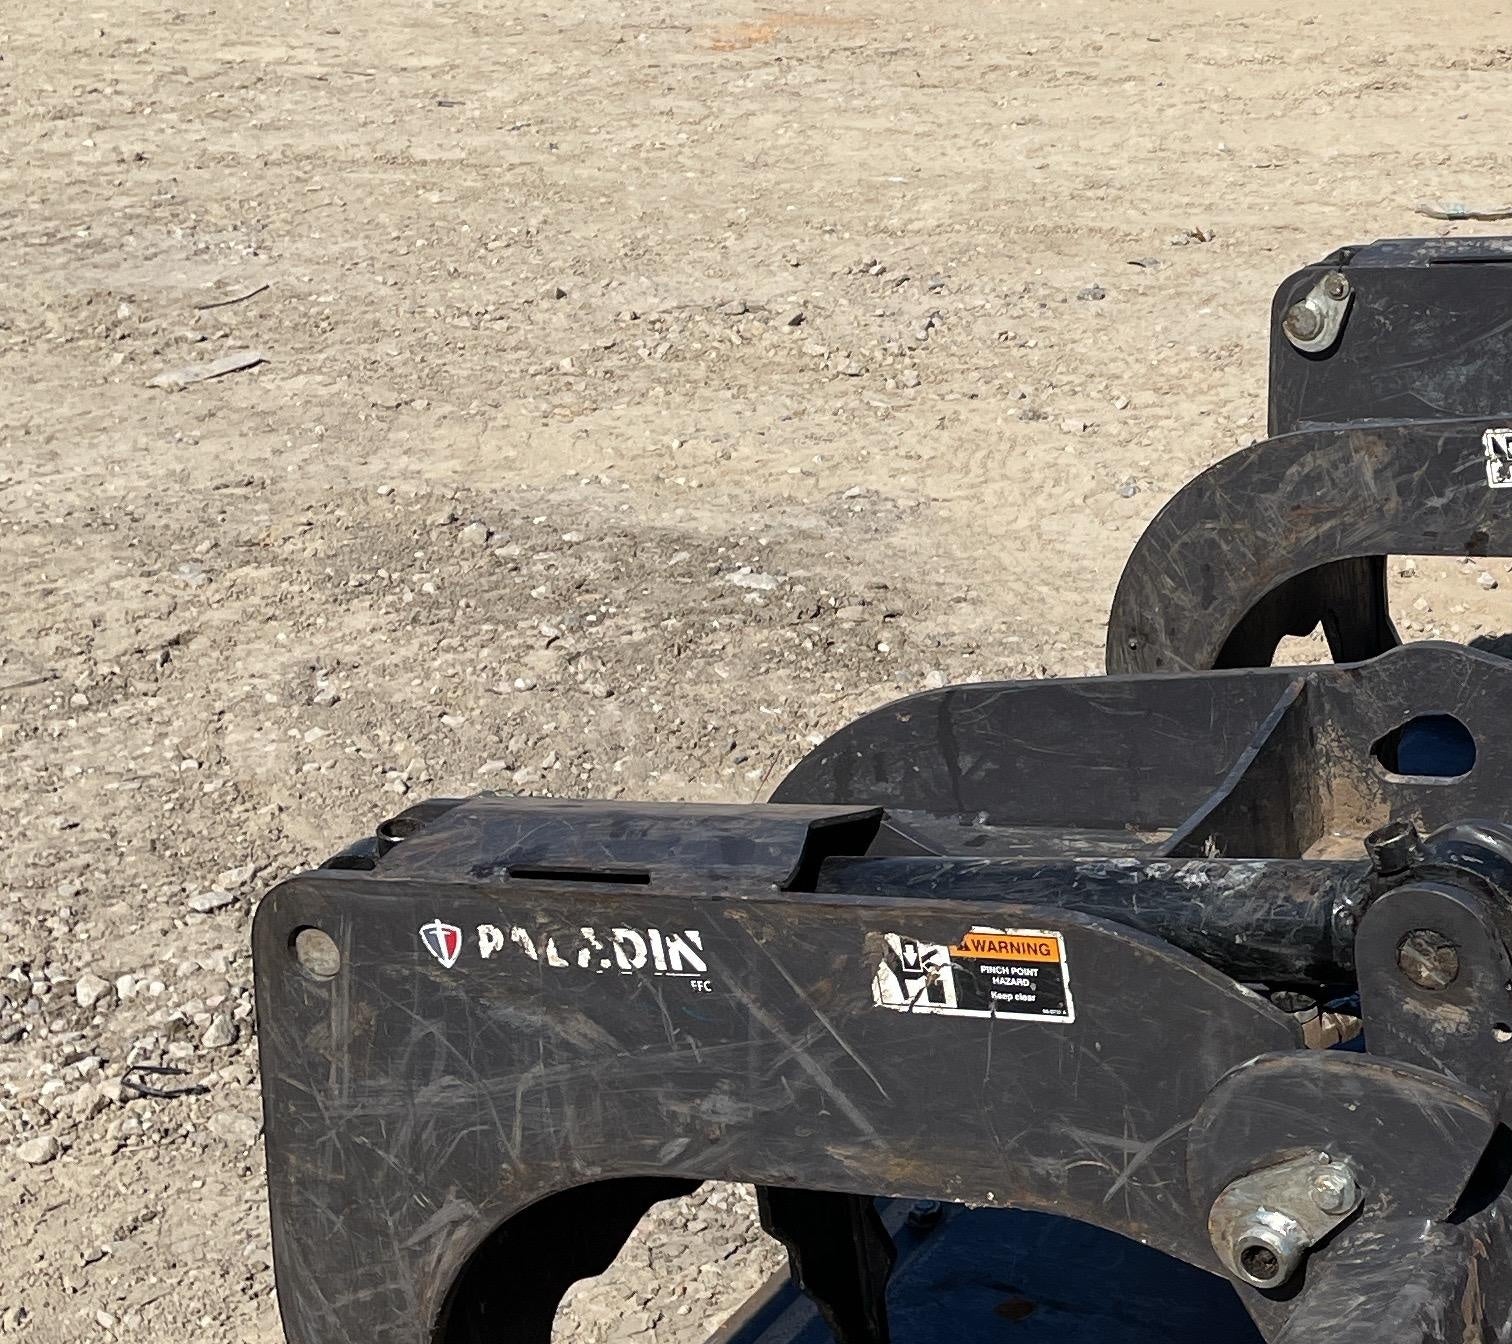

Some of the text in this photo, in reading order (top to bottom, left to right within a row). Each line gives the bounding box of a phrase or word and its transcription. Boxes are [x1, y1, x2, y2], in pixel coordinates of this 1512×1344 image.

[971, 939, 1051, 956] WARNING
[980, 965, 1039, 976] PINCH POINT
[992, 977, 1030, 987] HAZARD
